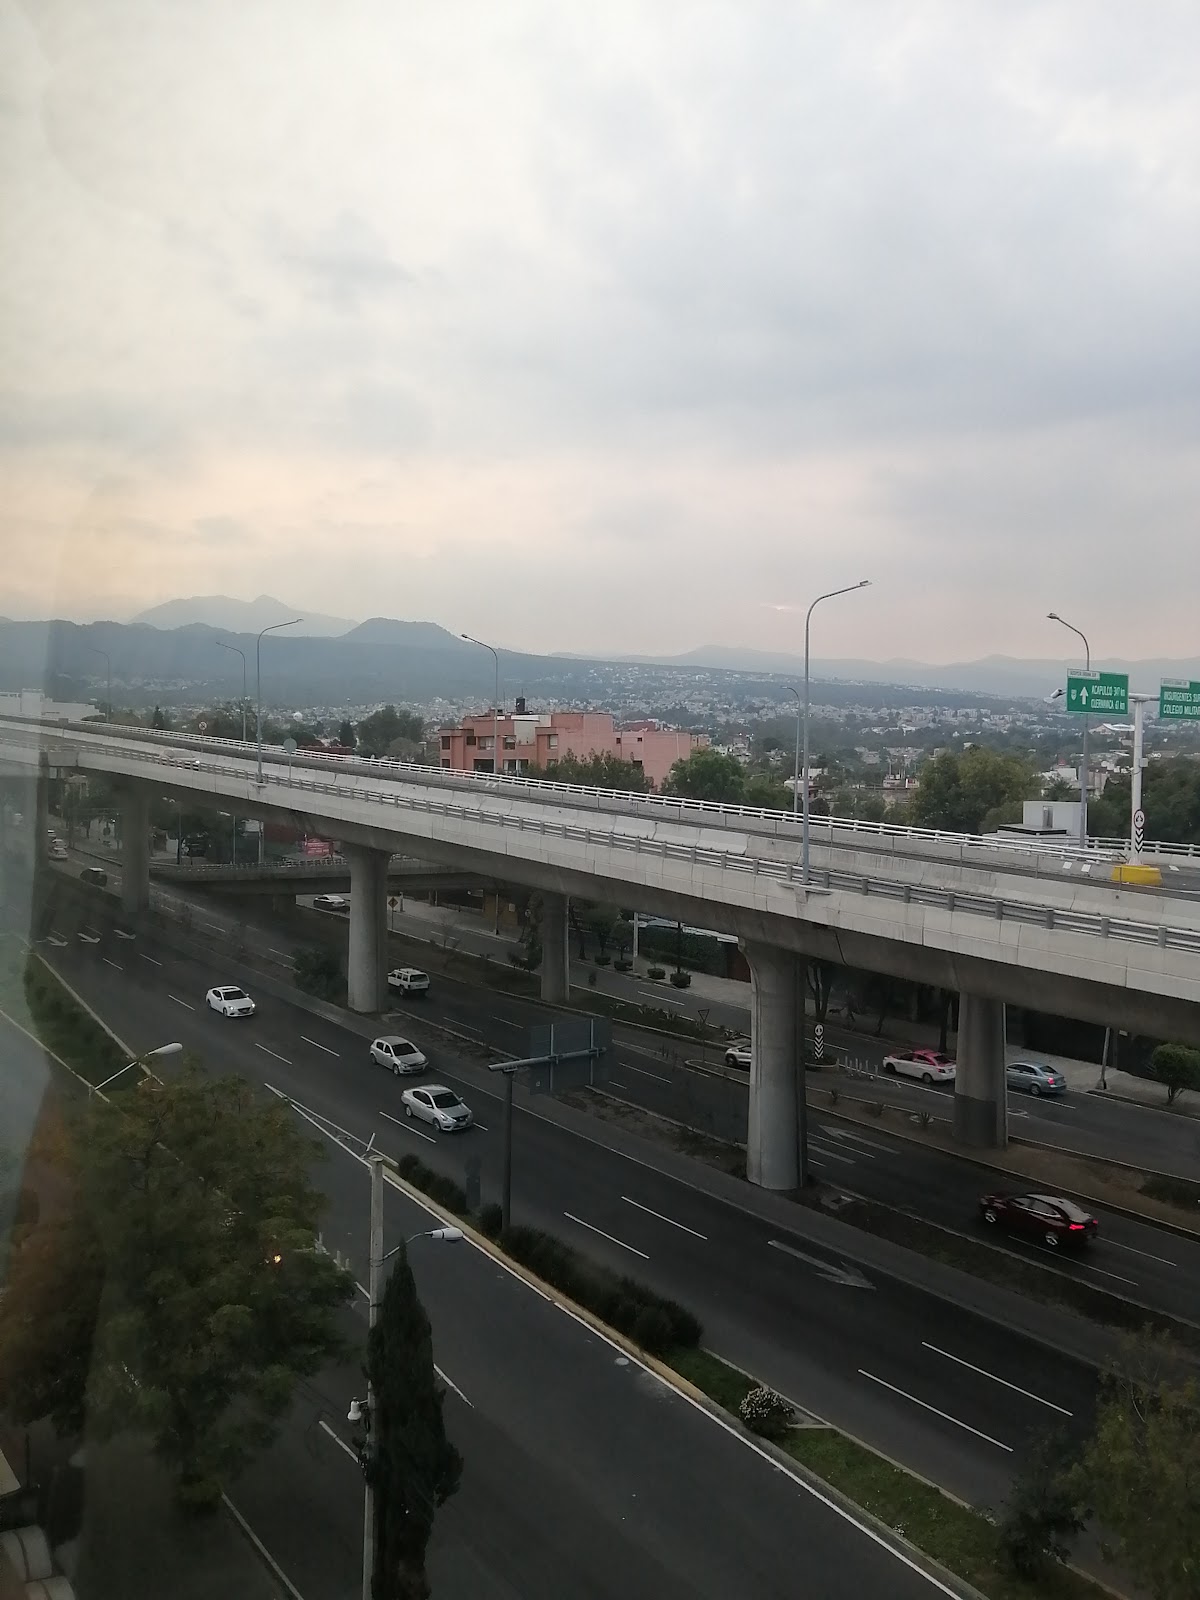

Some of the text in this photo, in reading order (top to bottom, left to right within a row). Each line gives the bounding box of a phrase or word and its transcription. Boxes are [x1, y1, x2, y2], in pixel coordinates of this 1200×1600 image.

[1091, 685, 1113, 696] ACAPULCO
[1163, 691, 1192, 702] INSURGENTES
[1163, 704, 1183, 714] COLEGIO
